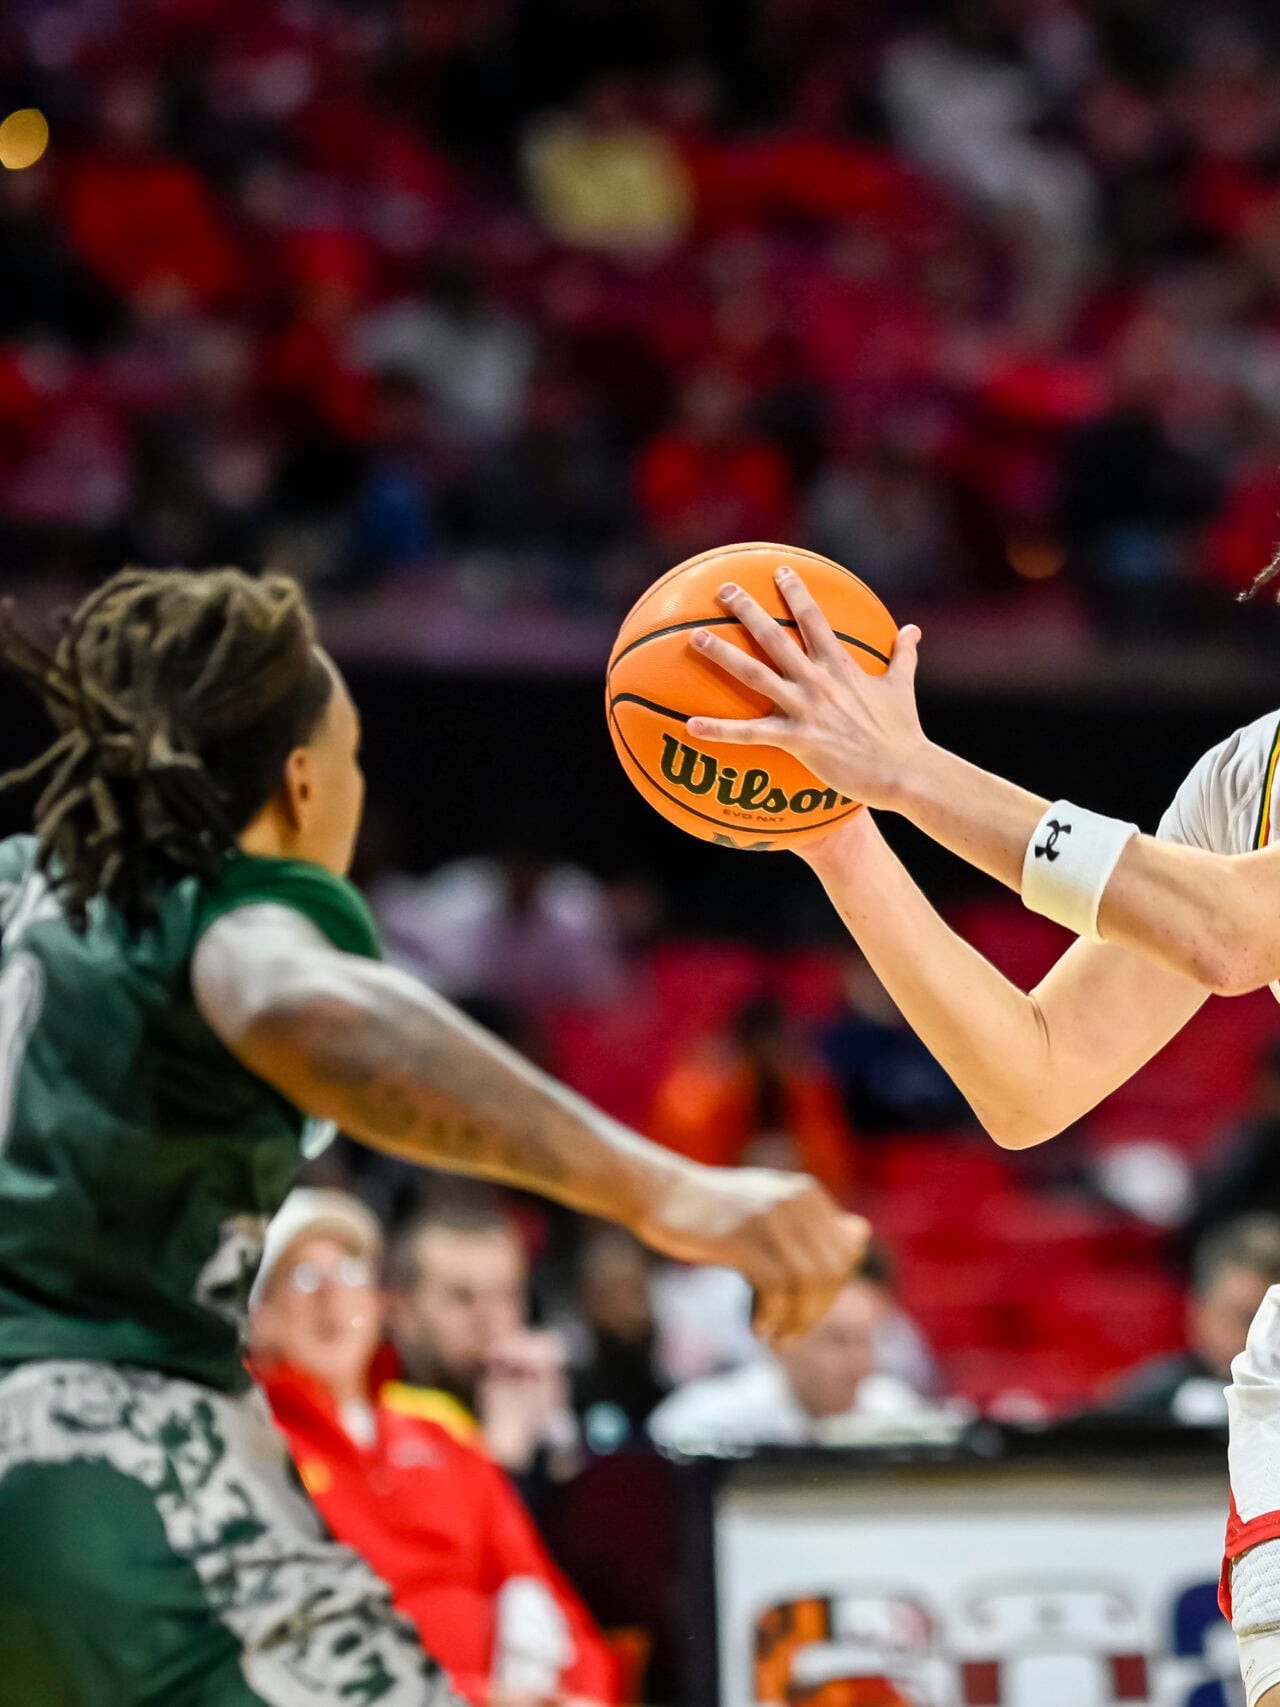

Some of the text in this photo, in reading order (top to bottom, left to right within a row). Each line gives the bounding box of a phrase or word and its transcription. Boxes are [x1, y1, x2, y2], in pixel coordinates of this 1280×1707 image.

[660, 732, 853, 814] Wilson
[723, 809, 786, 823] EVO NXT
